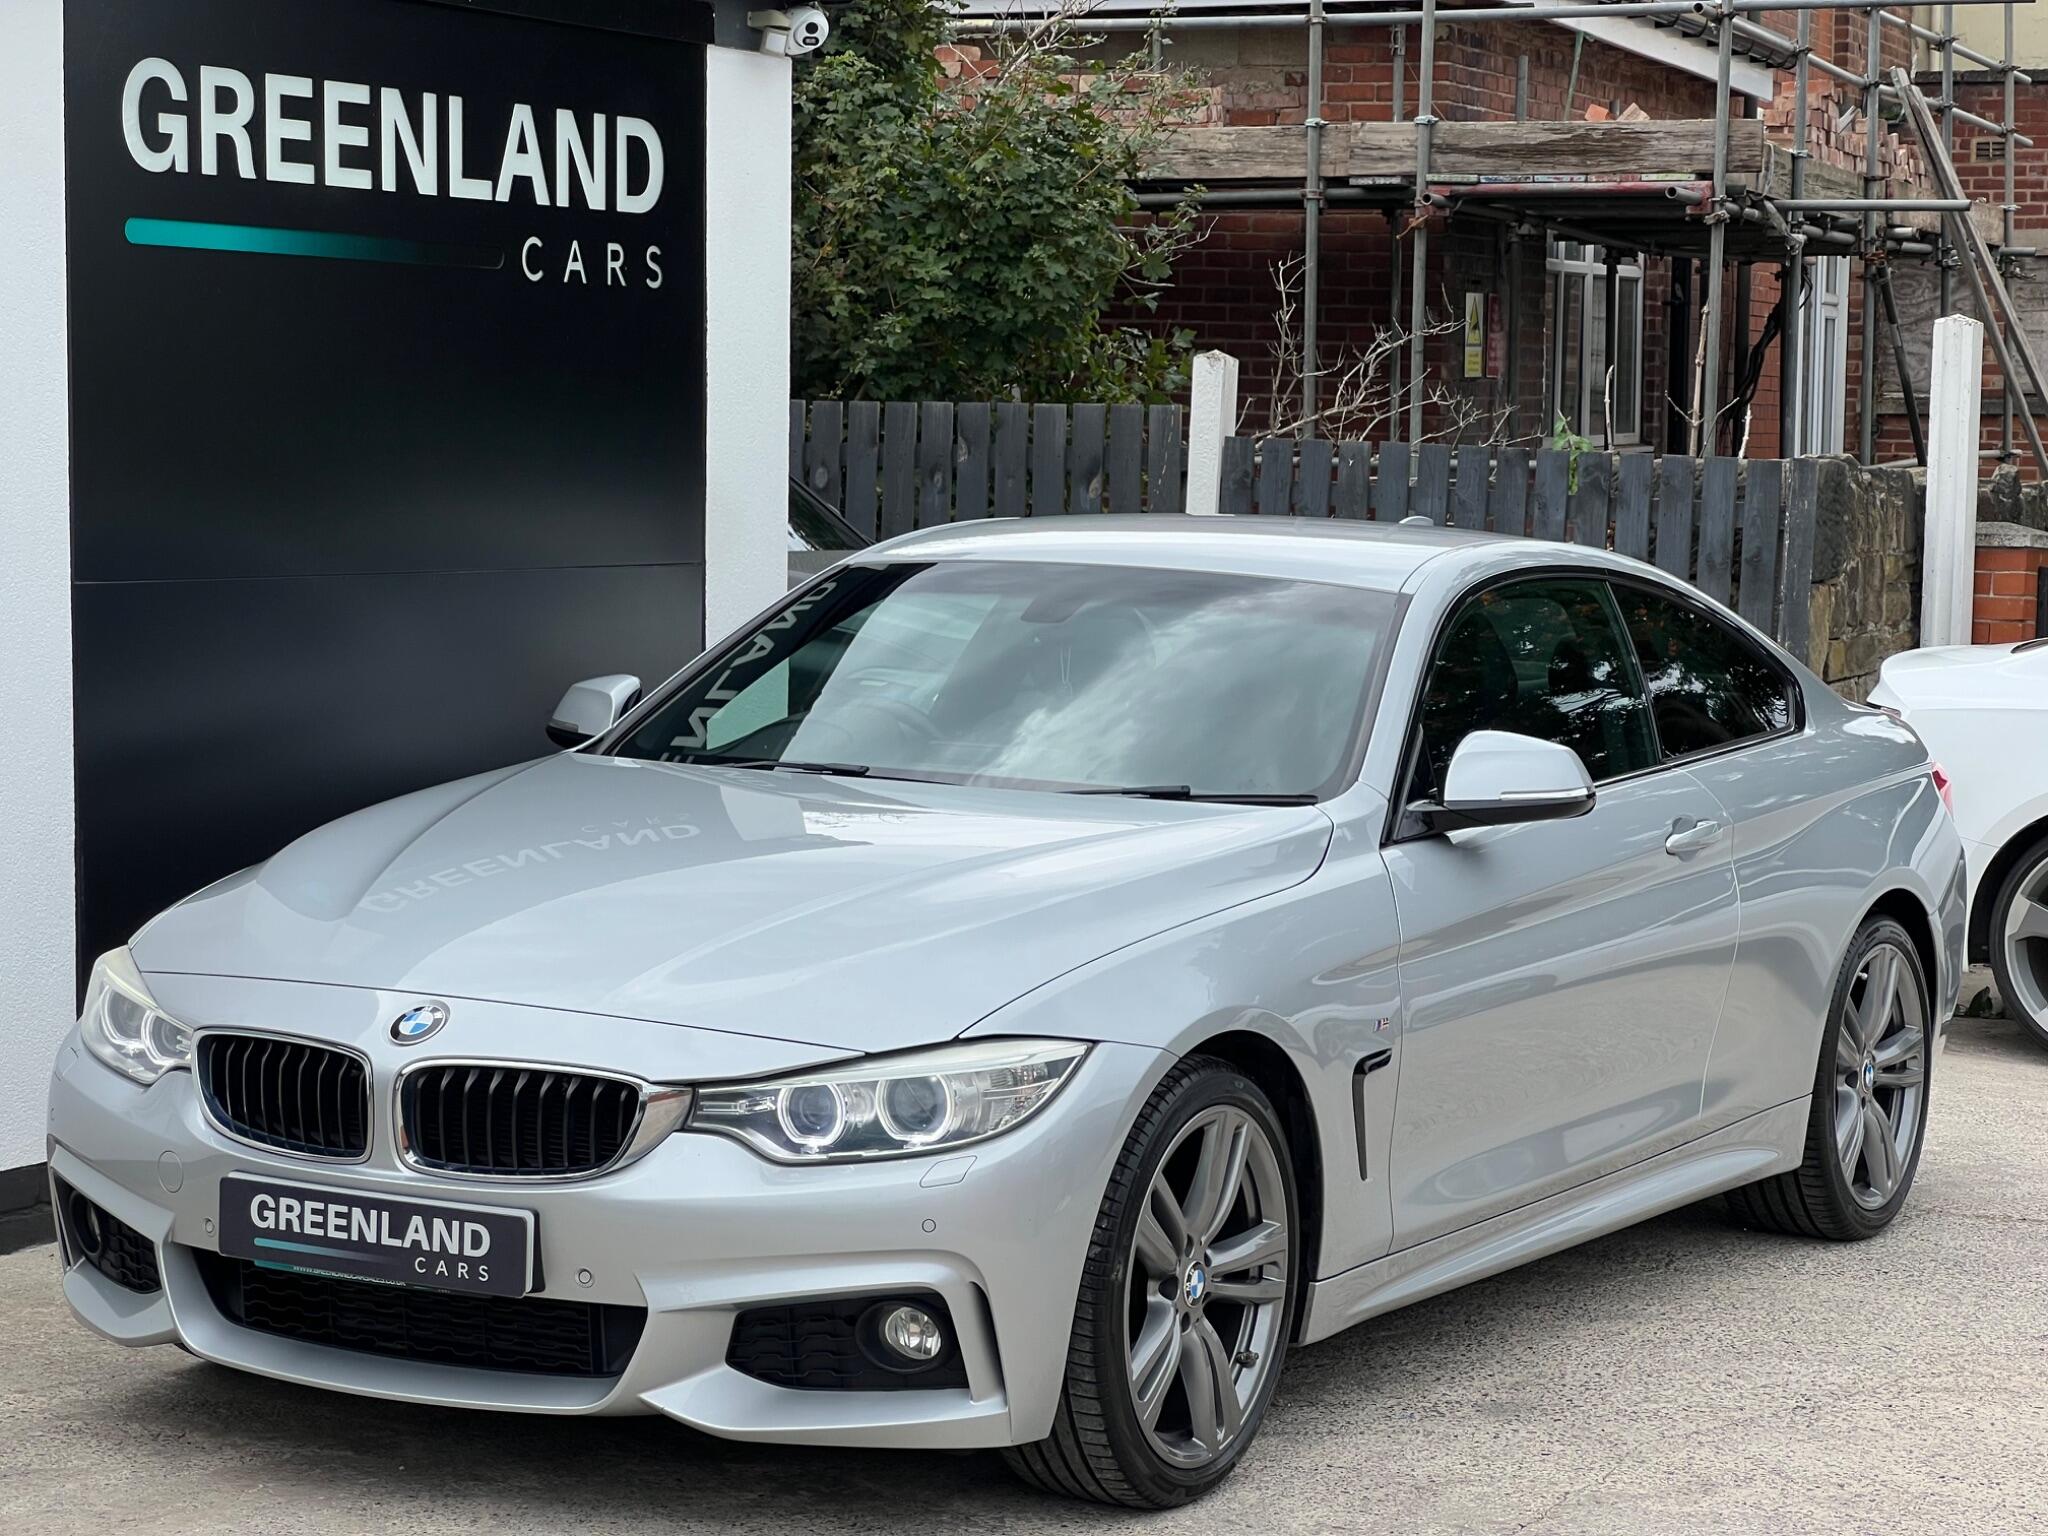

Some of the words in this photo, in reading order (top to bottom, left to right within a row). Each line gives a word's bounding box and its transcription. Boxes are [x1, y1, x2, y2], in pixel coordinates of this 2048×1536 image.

[122, 57, 664, 214] GREENLAND
[521, 236, 664, 289] CARS
[250, 1193, 491, 1258] GREENLAND
[414, 1256, 490, 1282] CARS
